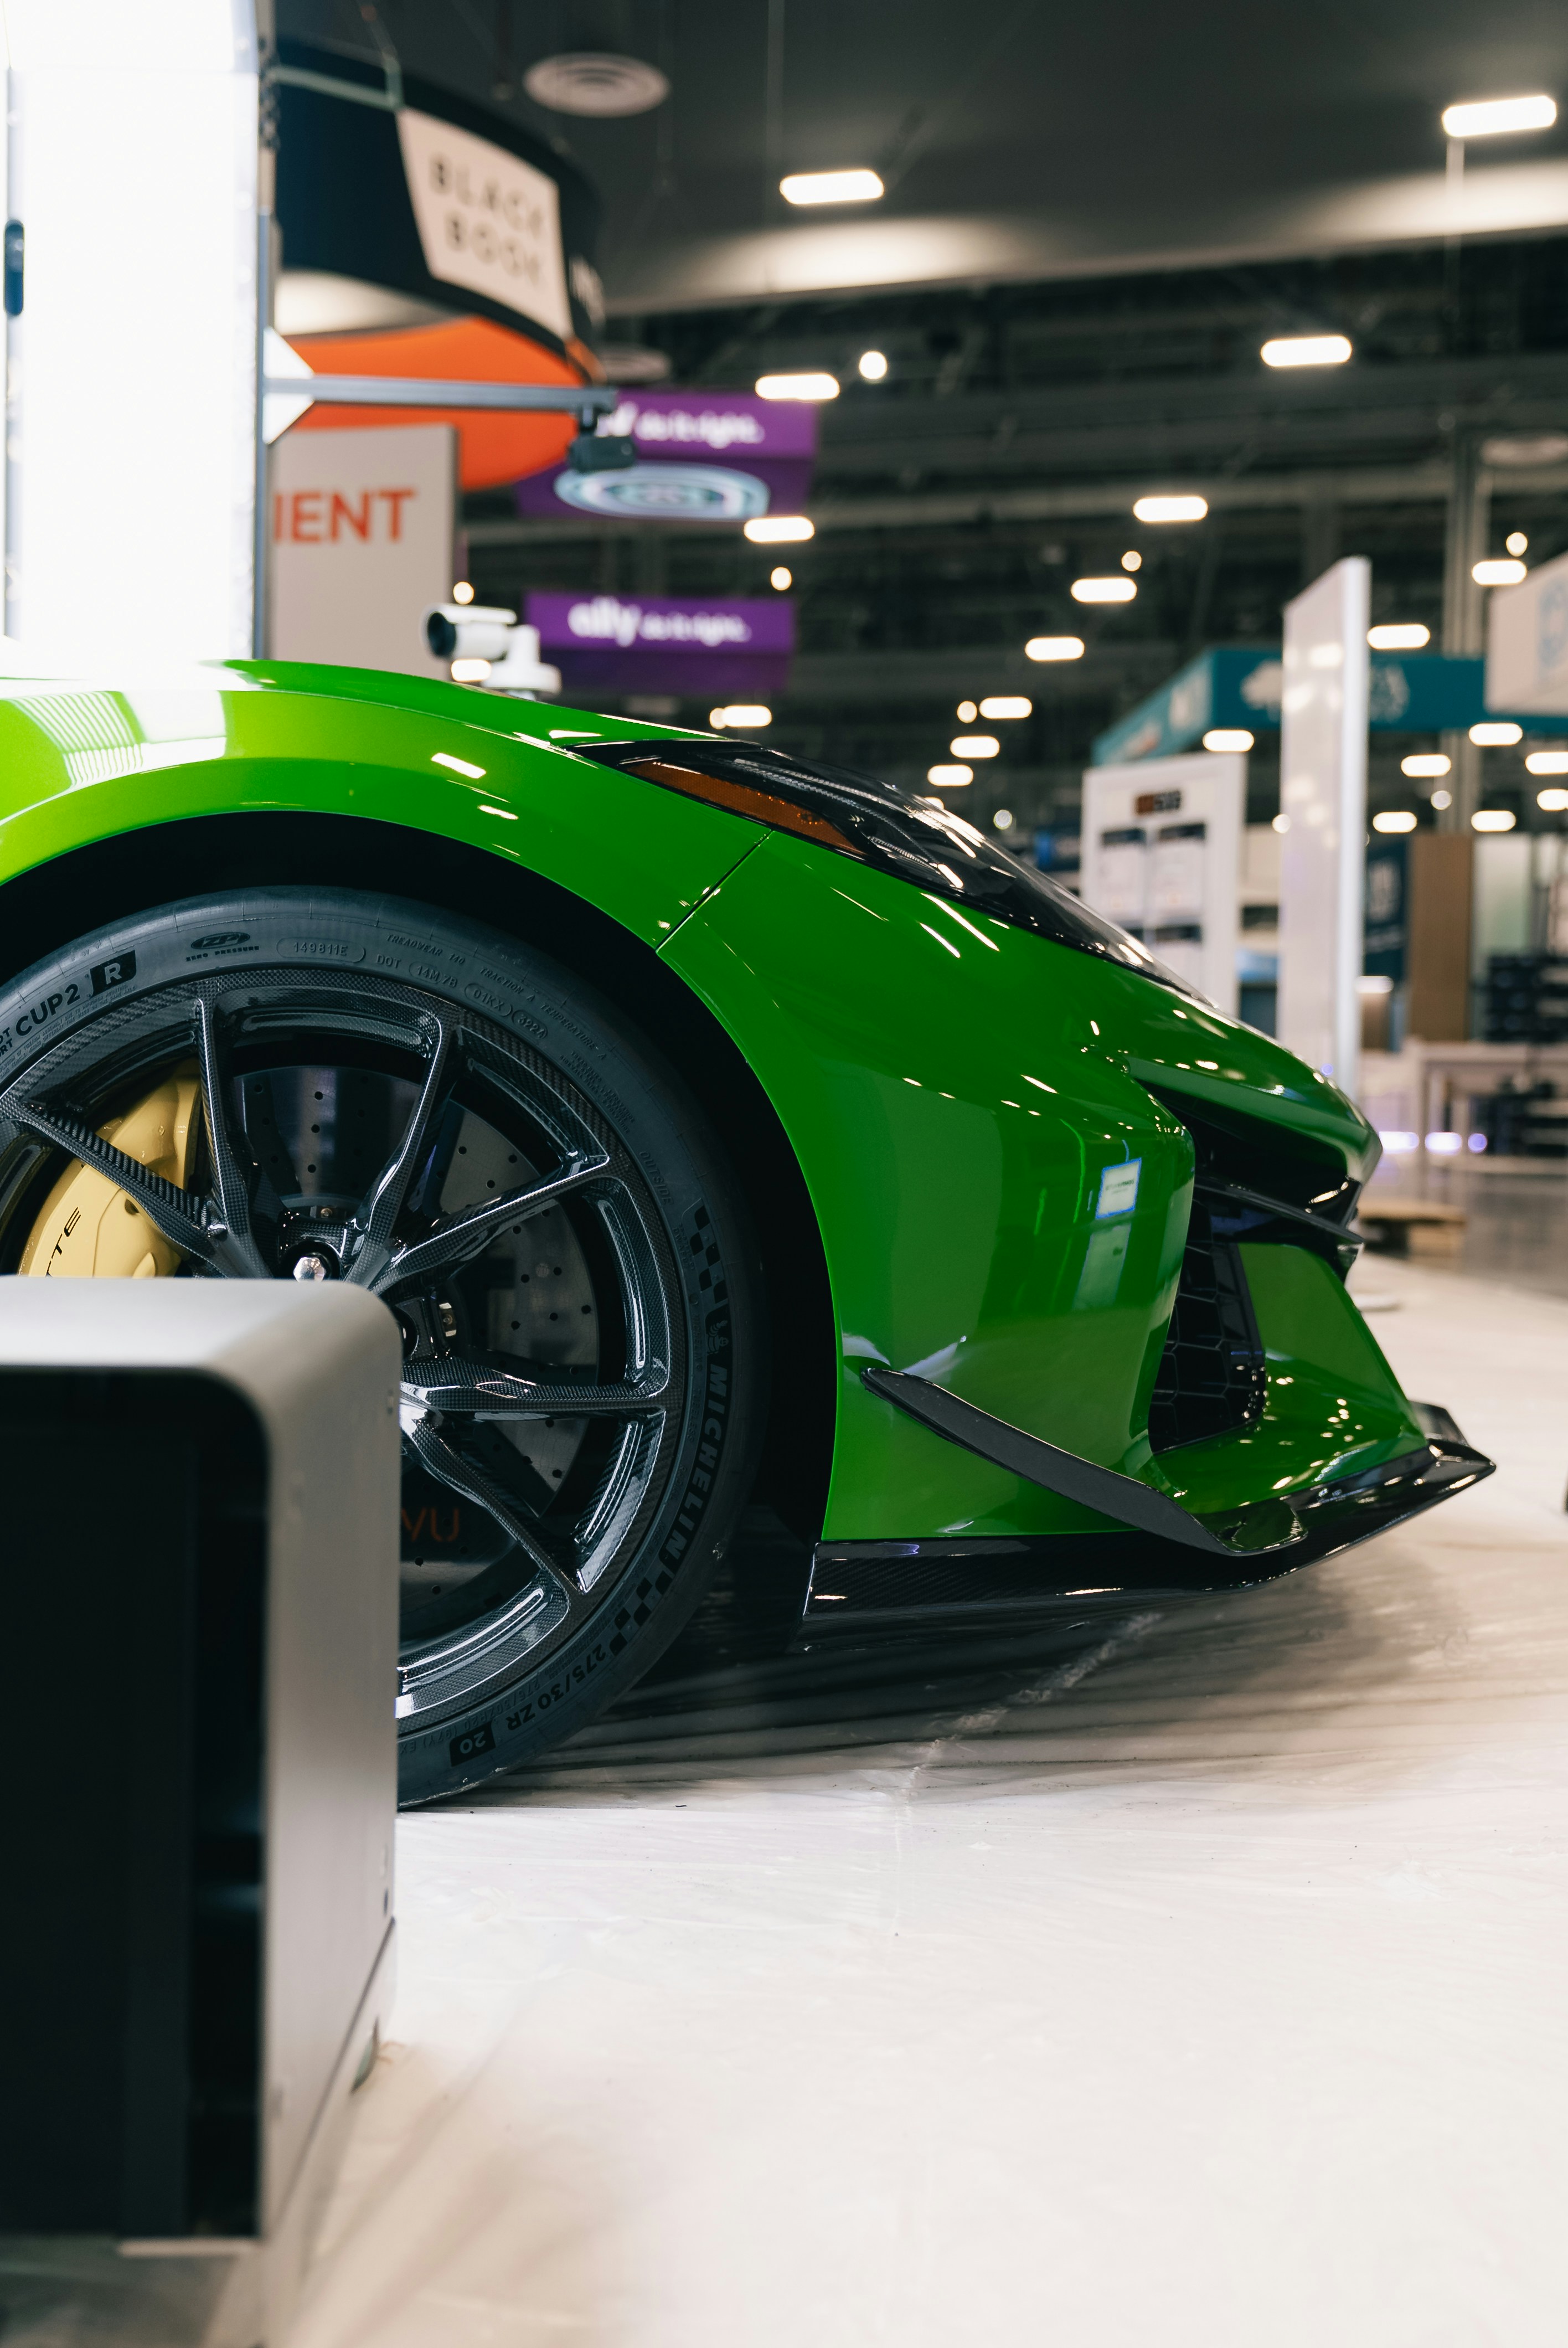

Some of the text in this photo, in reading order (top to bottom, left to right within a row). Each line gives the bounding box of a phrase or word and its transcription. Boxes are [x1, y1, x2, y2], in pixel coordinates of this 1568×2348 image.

[186, 945, 260, 962] ZERO PRESSURE
[293, 941, 348, 957] 149811E
[375, 953, 401, 970] DOT
[104, 962, 122, 985] R
[386, 933, 443, 957] TREADWEAR
[448, 952, 467, 966] 140
[479, 965, 524, 996] TRACTION
[540, 1001, 597, 1051] TEMPERATURE
[637, 1147, 675, 1208] OUTSIDE
[661, 1363, 729, 1559] MICHELIN
[456, 1642, 611, 1755] 275/30 ZR 20
